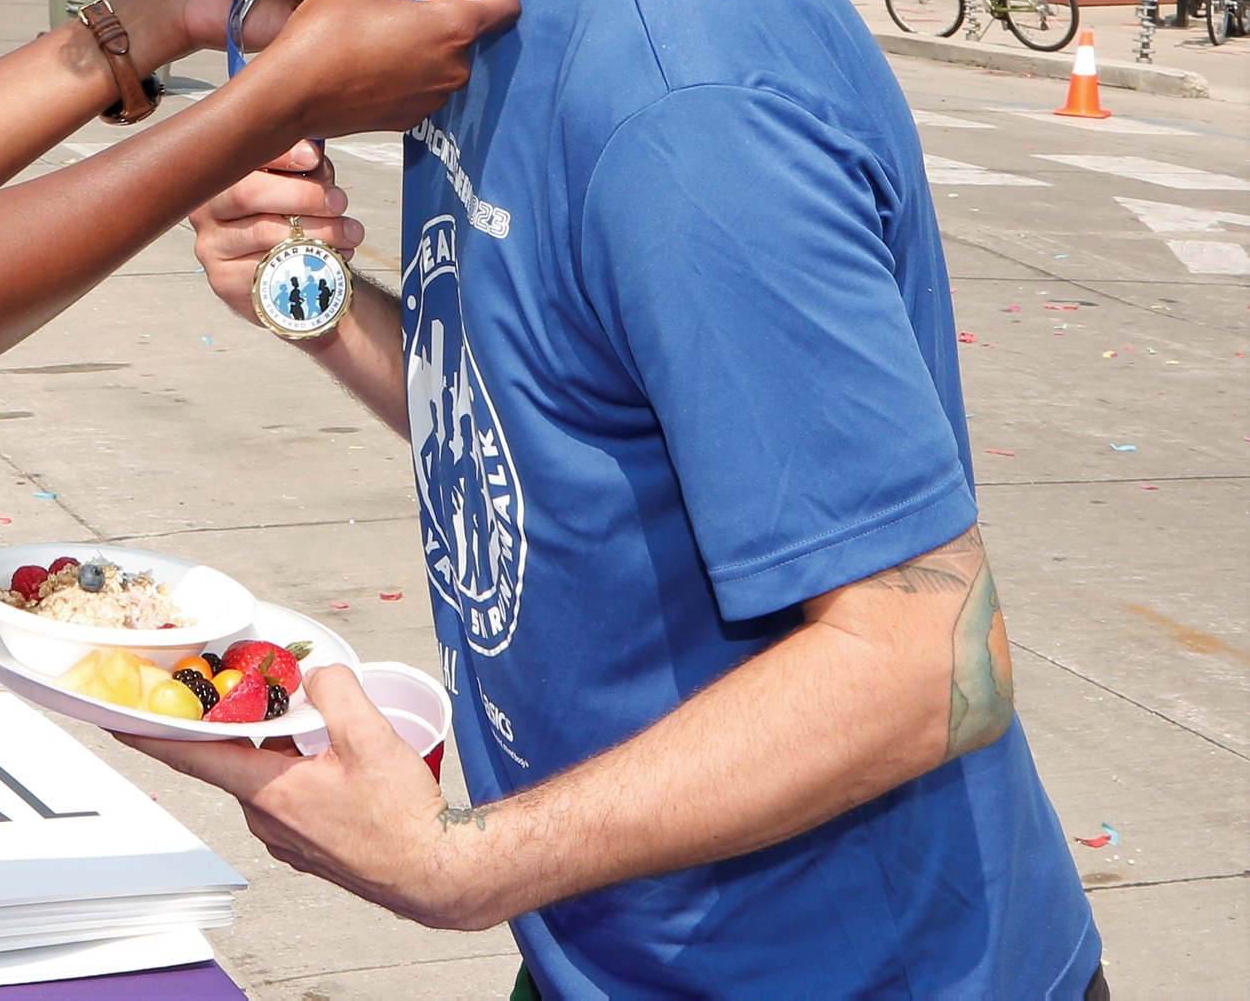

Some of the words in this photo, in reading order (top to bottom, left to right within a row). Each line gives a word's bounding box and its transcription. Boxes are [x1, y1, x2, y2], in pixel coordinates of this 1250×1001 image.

[270, 247, 299, 268] FEAR
[305, 246, 330, 262] MKE
[311, 319, 324, 327] 5K
[324, 268, 345, 319] RUN/WALK
